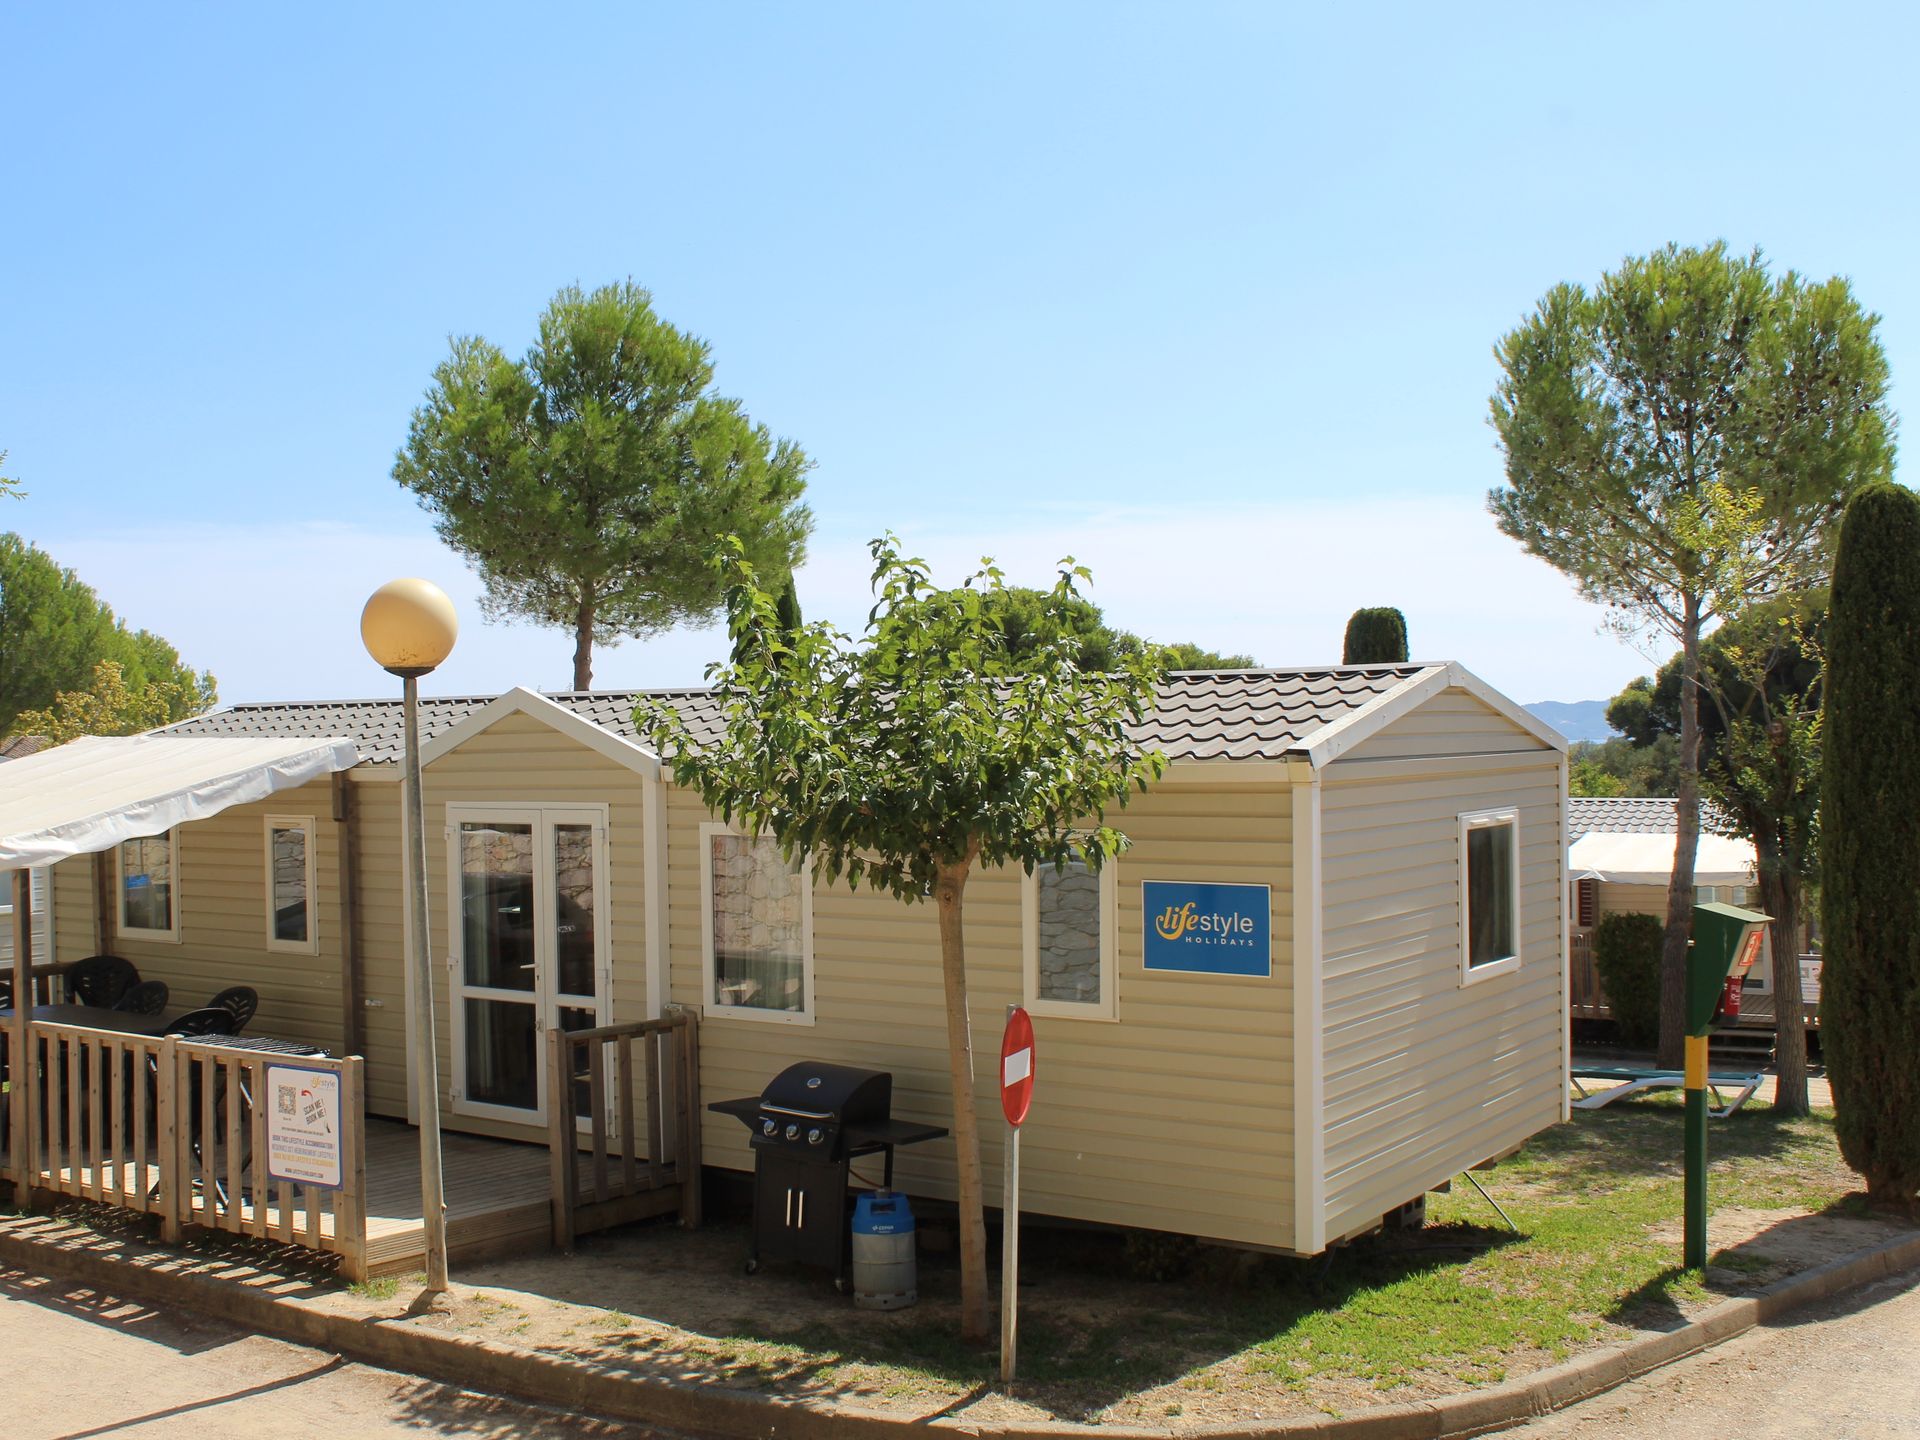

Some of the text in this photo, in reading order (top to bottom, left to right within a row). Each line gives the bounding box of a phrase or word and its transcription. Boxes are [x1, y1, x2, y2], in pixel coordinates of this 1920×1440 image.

[1156, 902, 1254, 940] lifestyle
[1185, 936, 1254, 946] HOLIDAYS
[303, 1103, 315, 1116] SCAN
[305, 1113, 318, 1125] BOOK
[305, 1139, 333, 1149] ACCOTION
